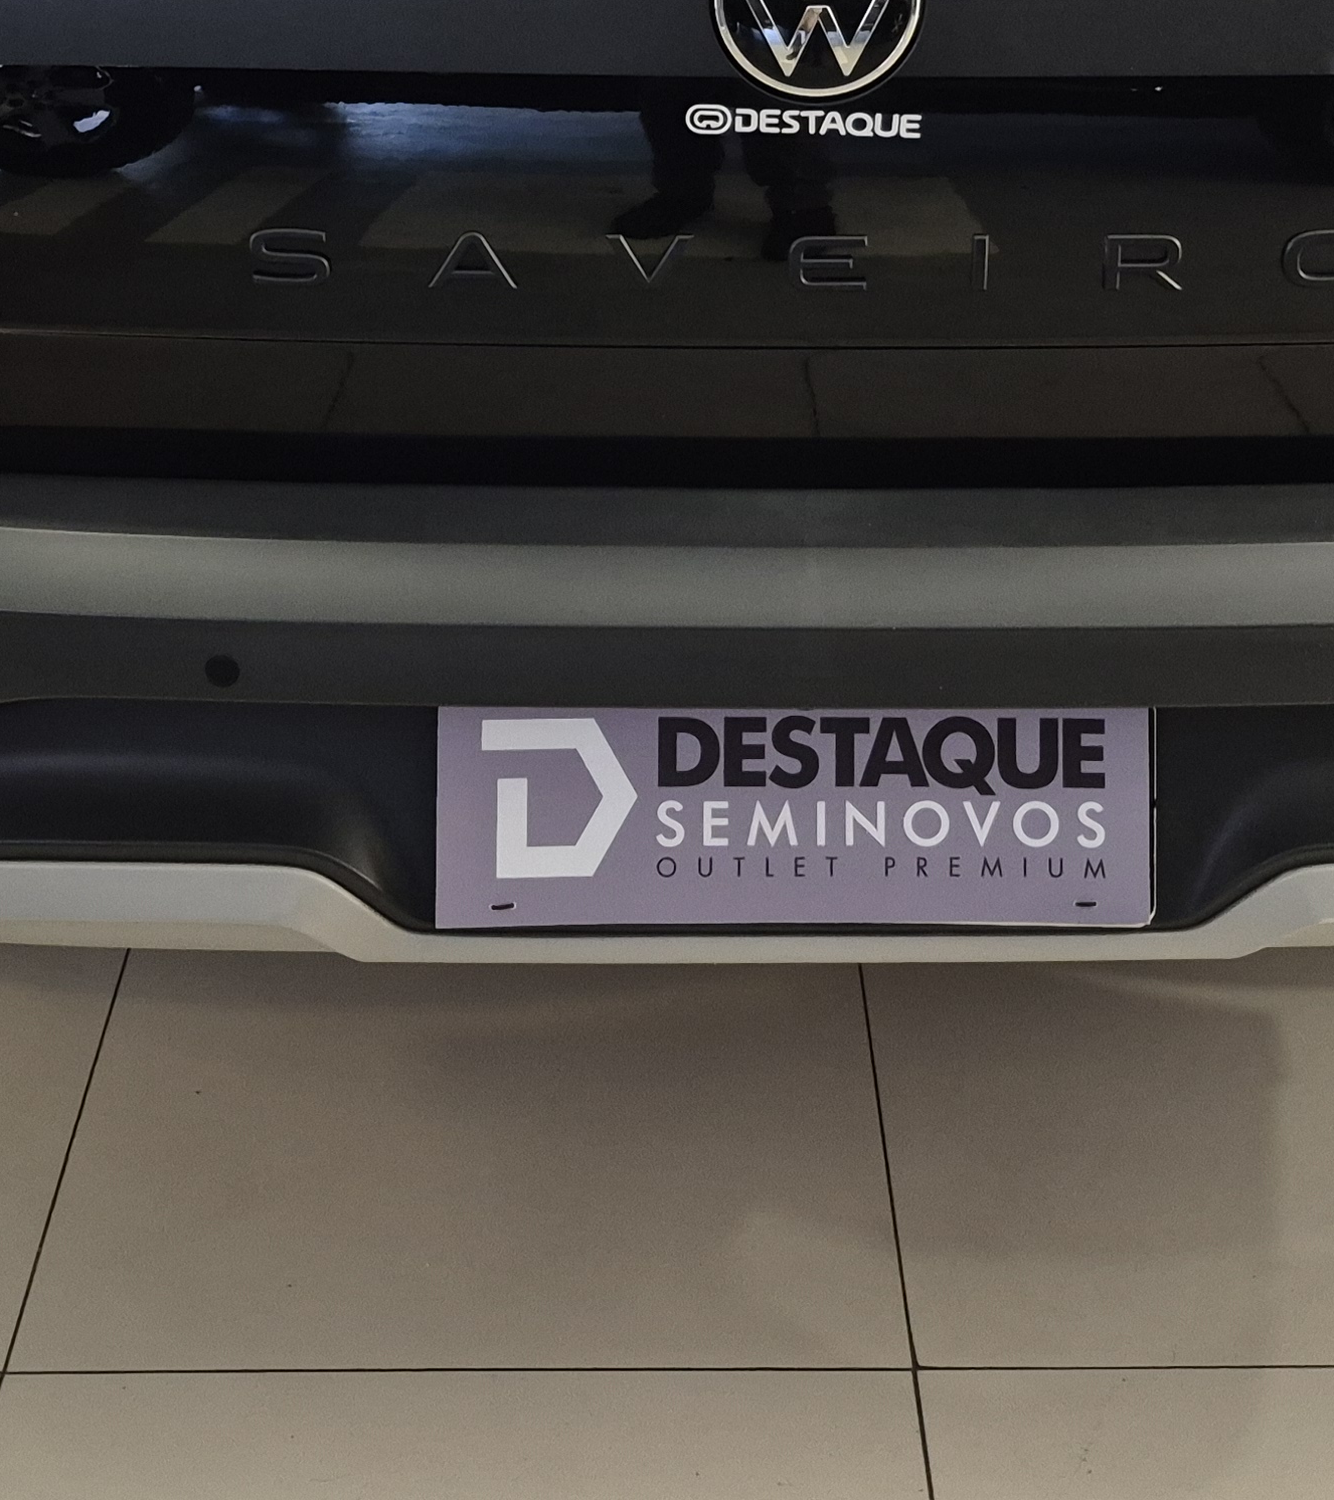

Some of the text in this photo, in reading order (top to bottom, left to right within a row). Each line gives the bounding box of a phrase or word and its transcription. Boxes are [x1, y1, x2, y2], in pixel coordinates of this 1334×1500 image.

[734, 108, 923, 139] DESTAQUE
[656, 716, 1107, 796] DESTAQUE
[656, 799, 1107, 849] SEMINOVOS
[656, 857, 1107, 879] OUTLET PREMIUM
